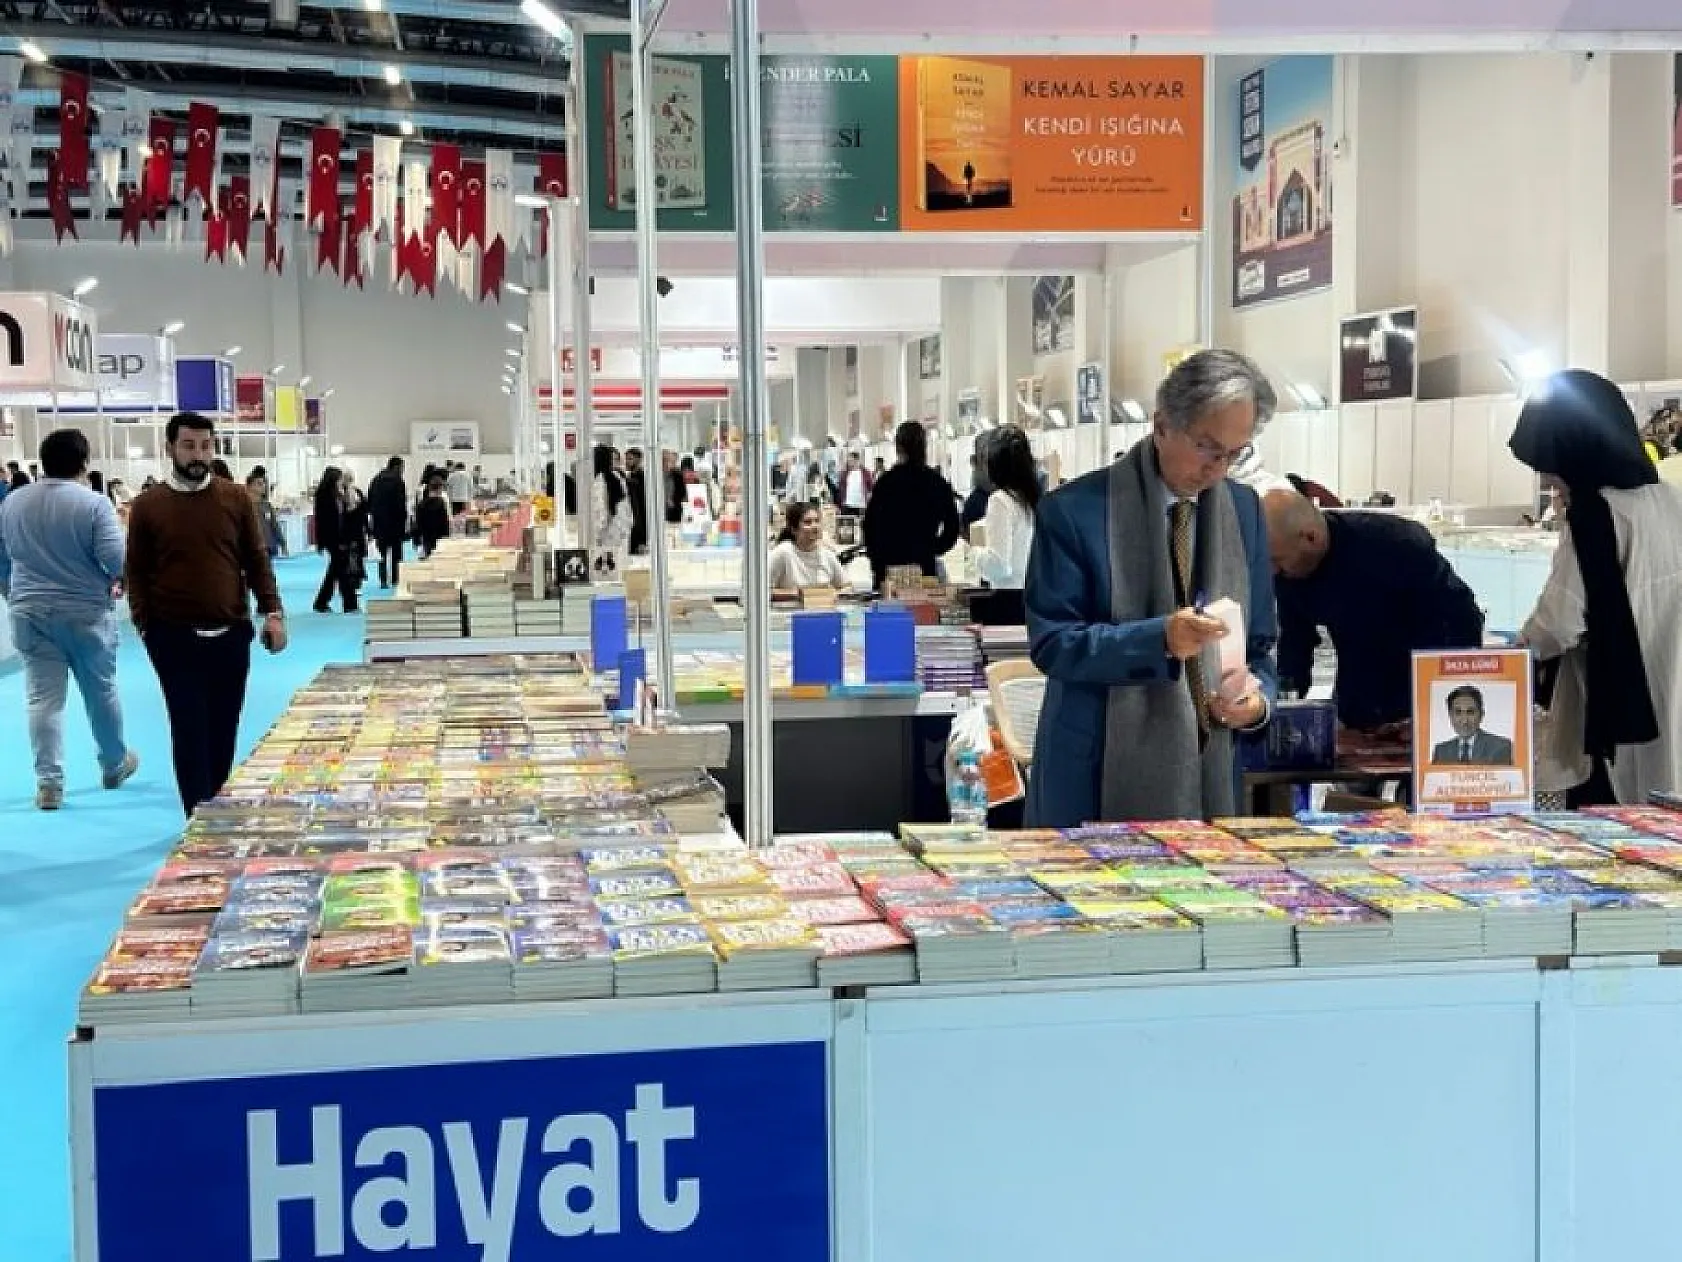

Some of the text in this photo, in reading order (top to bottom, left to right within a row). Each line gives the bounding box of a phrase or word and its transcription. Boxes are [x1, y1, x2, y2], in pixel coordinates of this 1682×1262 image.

[823, 66, 871, 82] PALA
[1023, 79, 1185, 99] KEMAL SAYAR
[1023, 113, 1185, 138] KENDİ IŞIĞINA
[1071, 145, 1137, 167] YÜRÜ
[246, 1082, 701, 1262] Hayat
